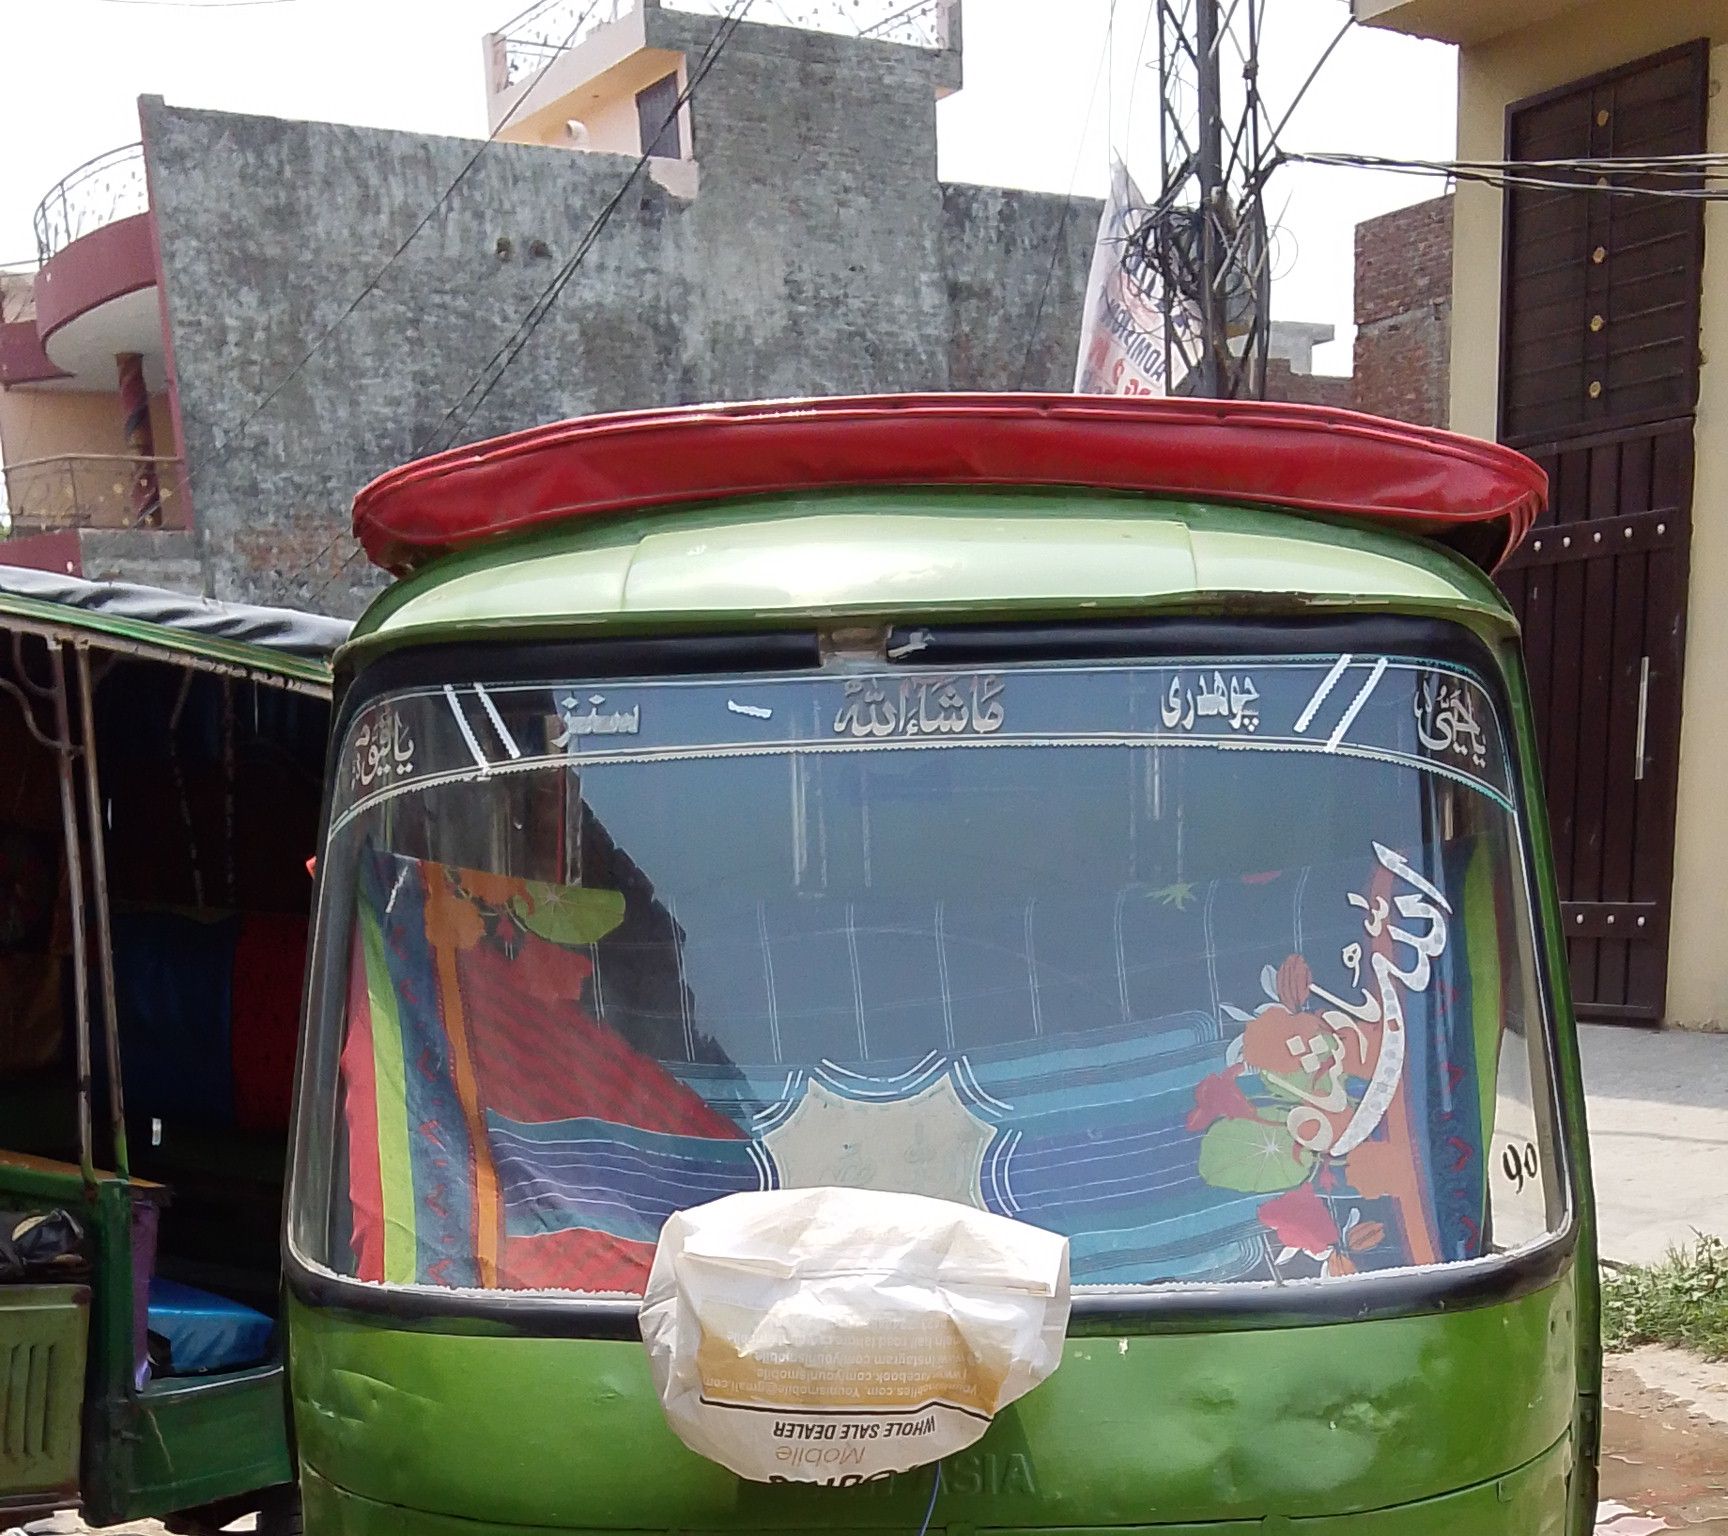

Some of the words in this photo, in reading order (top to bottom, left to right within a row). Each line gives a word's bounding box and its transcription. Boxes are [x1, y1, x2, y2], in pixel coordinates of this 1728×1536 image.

[773, 1421, 837, 1440] DEALER
[839, 1423, 881, 1439] SALE
[883, 1415, 935, 1438] WHOLE
[775, 1445, 866, 1467] Mobile
